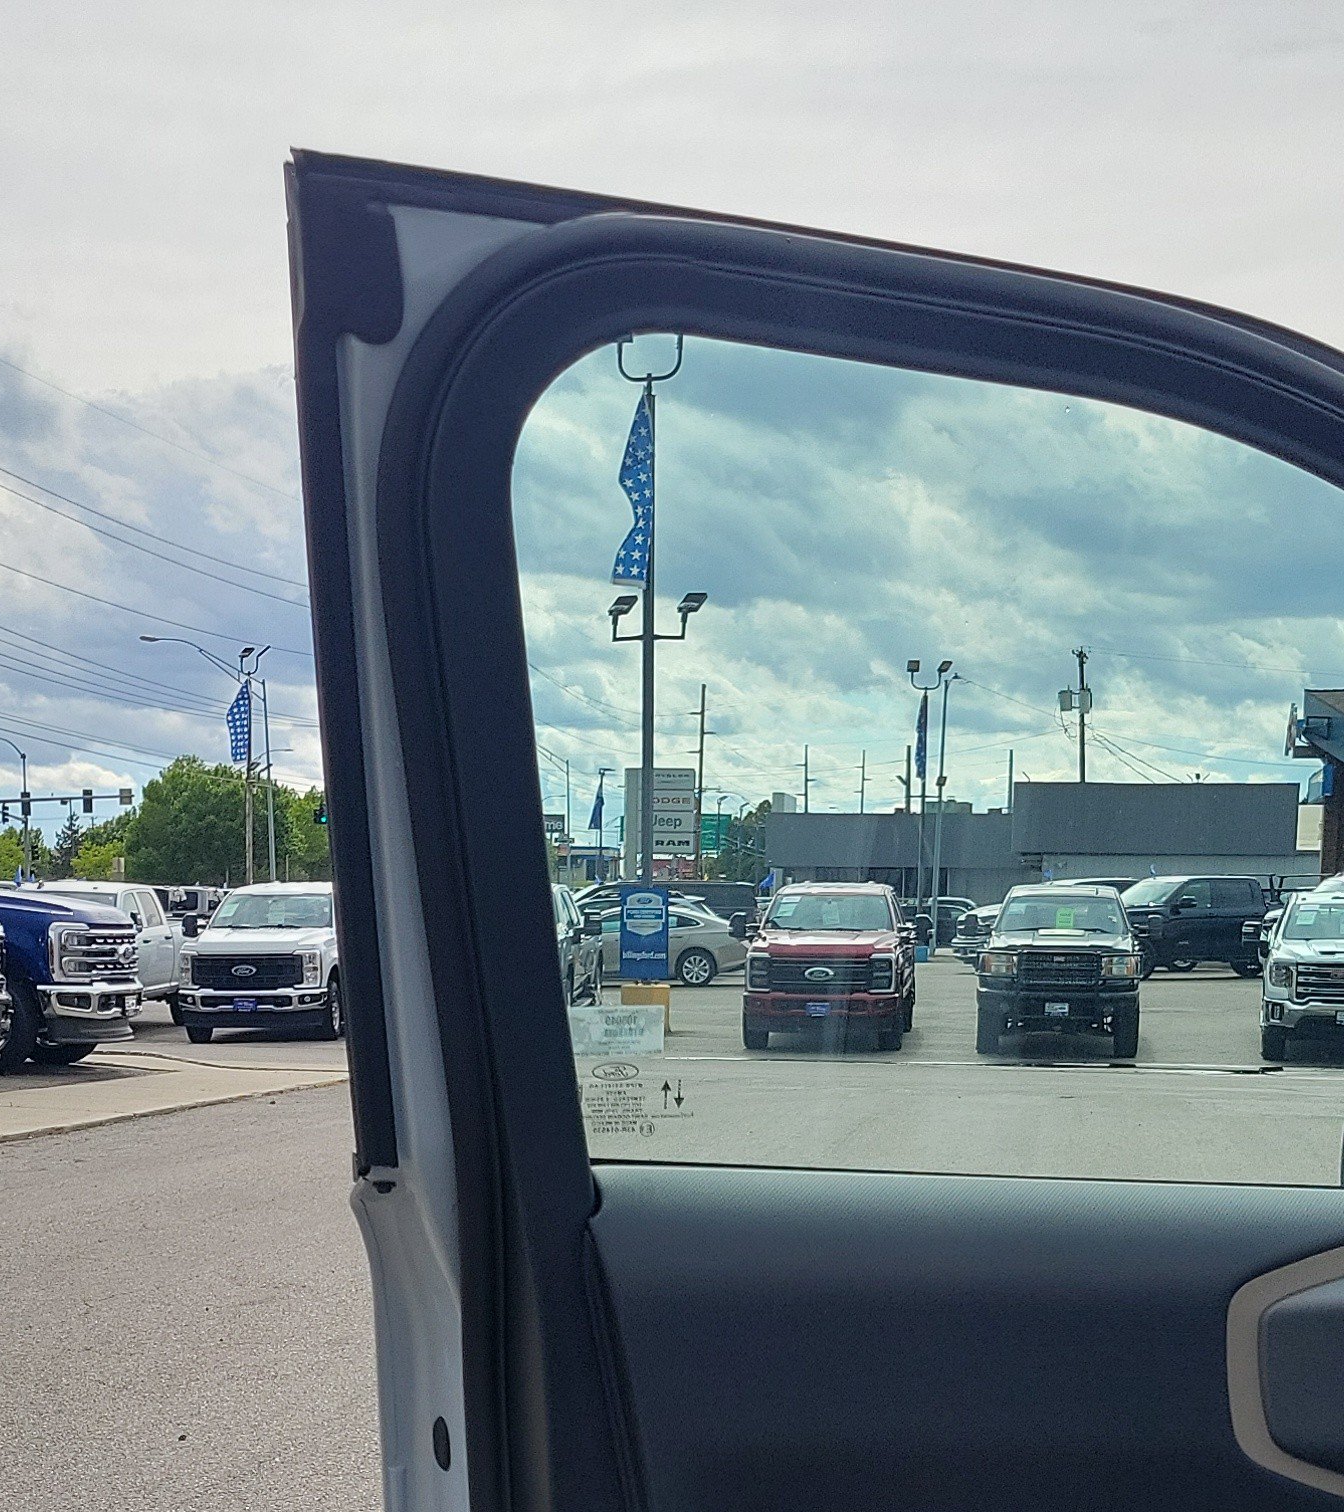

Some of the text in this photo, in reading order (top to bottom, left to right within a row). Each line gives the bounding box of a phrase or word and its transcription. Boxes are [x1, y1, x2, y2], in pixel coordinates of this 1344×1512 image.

[653, 797, 691, 805] ODGE
[652, 814, 683, 830] Jeep
[654, 839, 690, 847] RAM
